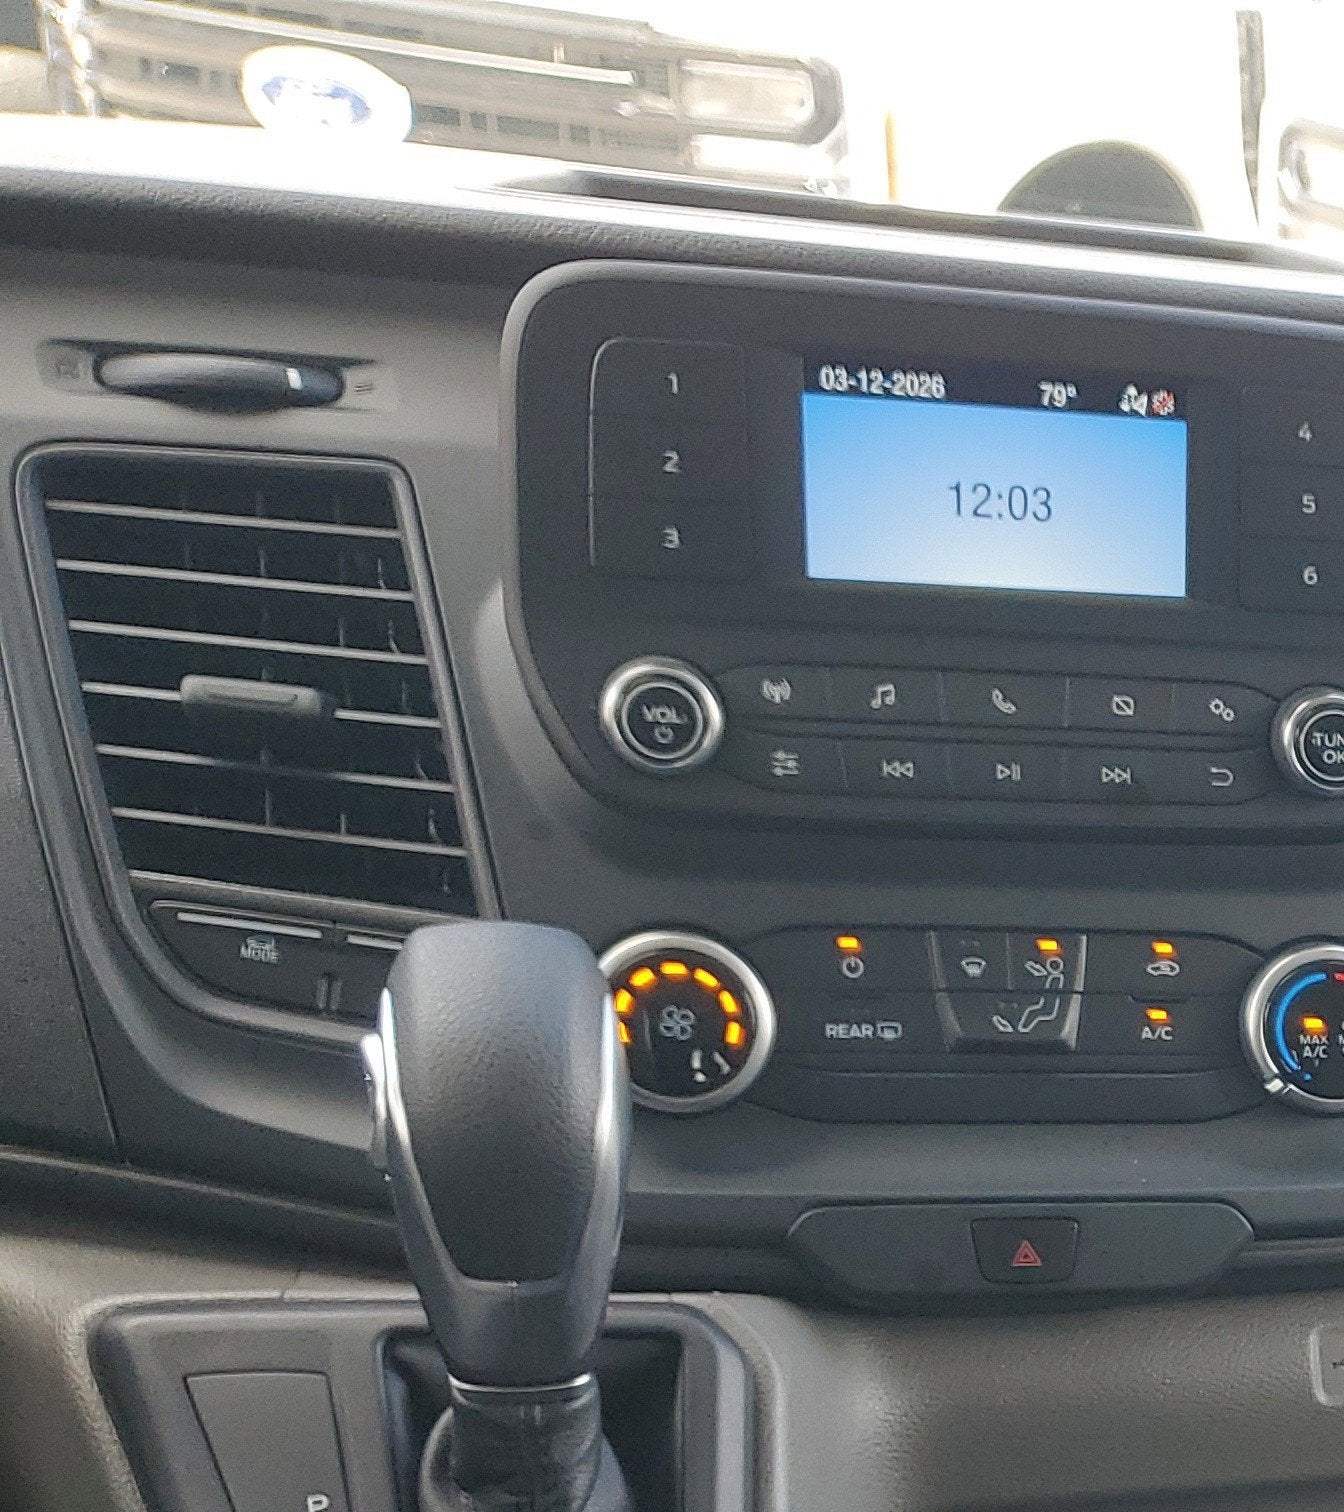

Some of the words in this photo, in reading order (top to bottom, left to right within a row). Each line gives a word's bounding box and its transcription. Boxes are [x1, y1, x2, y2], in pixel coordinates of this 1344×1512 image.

[668, 373, 680, 393] 1
[819, 365, 946, 398] 03-12-2026
[1297, 422, 1312, 442] 4
[662, 452, 681, 473] 2
[948, 481, 1053, 522] 12:03
[1302, 494, 1317, 515] 5
[662, 528, 681, 549] 3
[1303, 566, 1319, 586] 6
[641, 704, 687, 725] VOL
[824, 1021, 875, 1040] REAR
[1141, 1026, 1173, 1041] A/C
[1300, 1034, 1329, 1045] MAX
[1302, 1046, 1328, 1059] A/C
